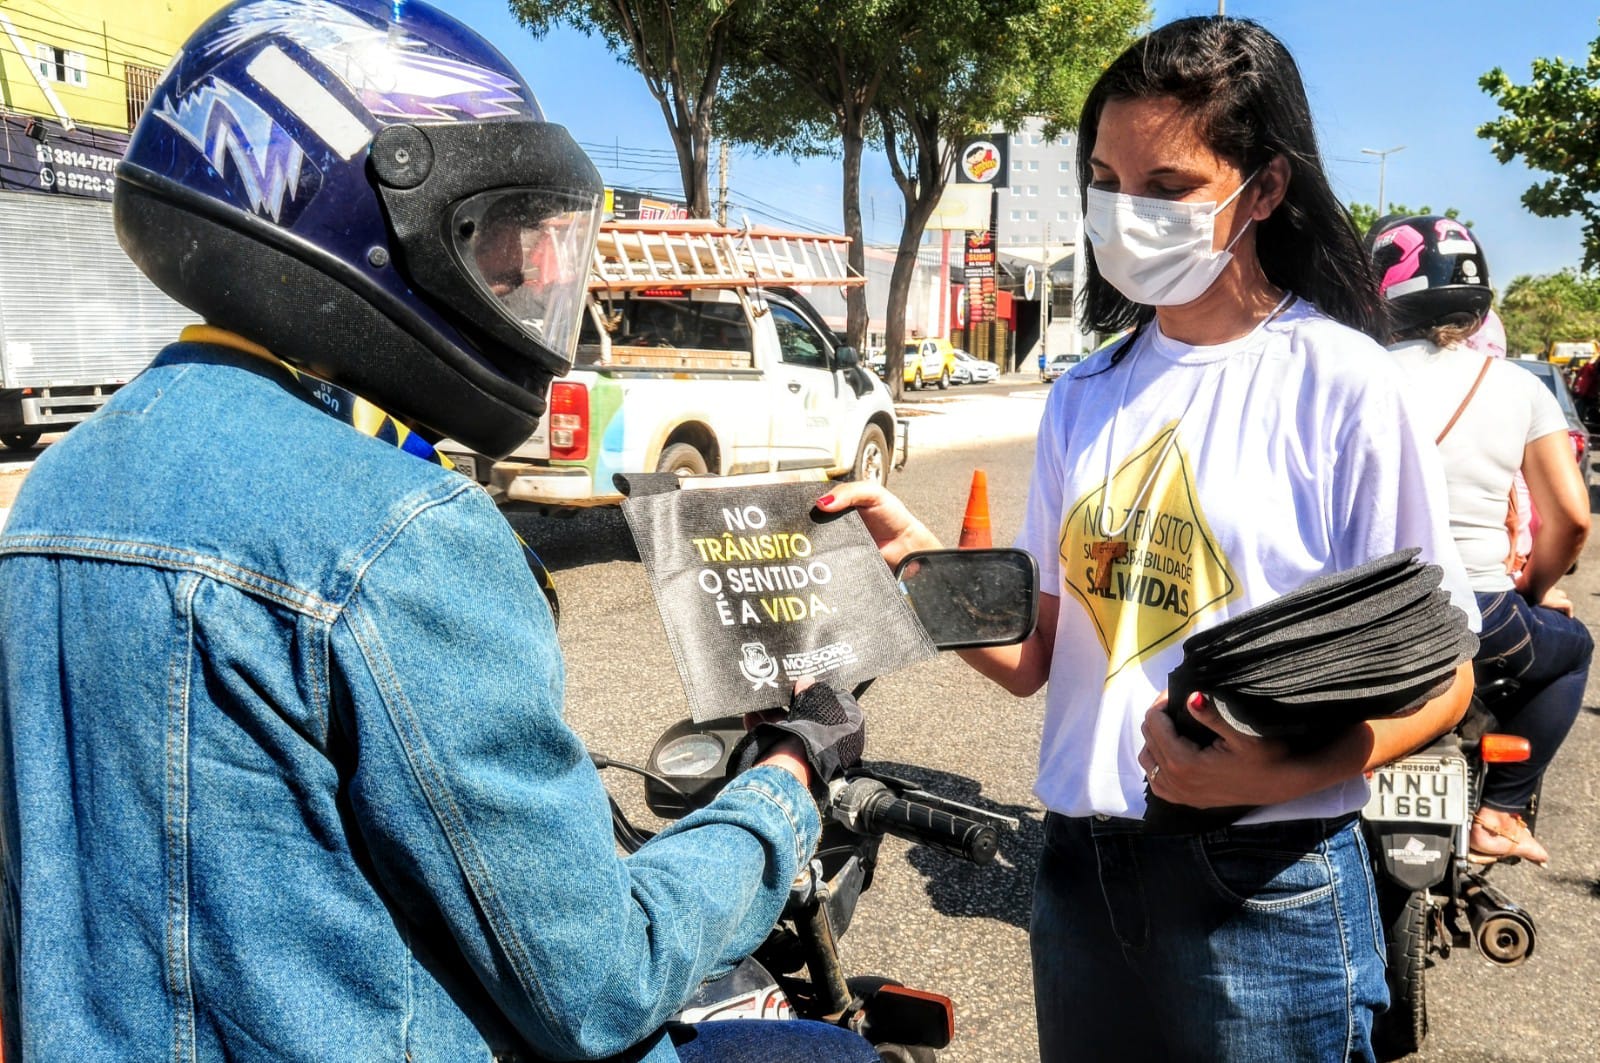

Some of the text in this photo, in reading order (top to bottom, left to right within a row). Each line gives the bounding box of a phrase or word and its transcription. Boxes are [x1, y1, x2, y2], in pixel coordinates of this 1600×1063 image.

[722, 505, 768, 531] NO
[1083, 504, 1114, 538] NO
[693, 532, 812, 562] TRÂNSITO
[698, 561, 833, 595] O SENTIDO
[716, 592, 838, 626] É A VIDA.
[1379, 773, 1449, 797] NNU
[1380, 795, 1447, 820] 1661
